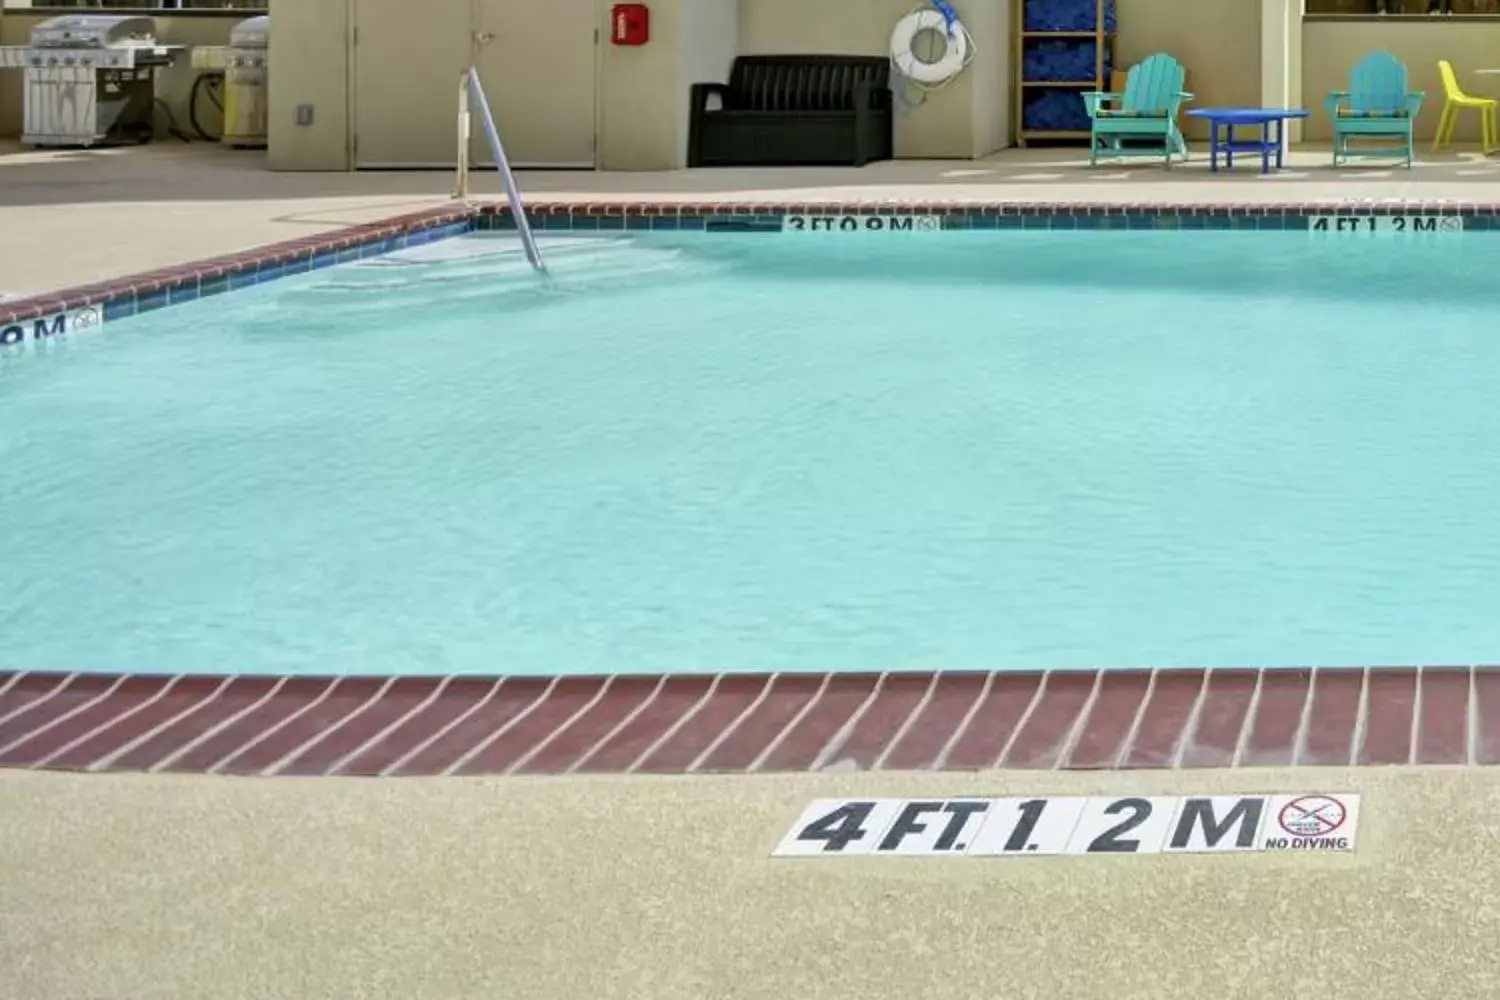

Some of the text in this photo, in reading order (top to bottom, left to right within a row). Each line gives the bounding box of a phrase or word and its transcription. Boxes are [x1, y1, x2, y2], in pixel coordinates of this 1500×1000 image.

[889, 217, 913, 231] M
[1313, 217, 1329, 232] 4
[1413, 217, 1437, 232] M
[34, 314, 66, 340] M
[797, 801, 877, 852] 4
[877, 801, 990, 851] FT.
[1087, 797, 1153, 852] 2
[1170, 797, 1265, 849] M
[1265, 837, 1348, 849] NO DIVING
